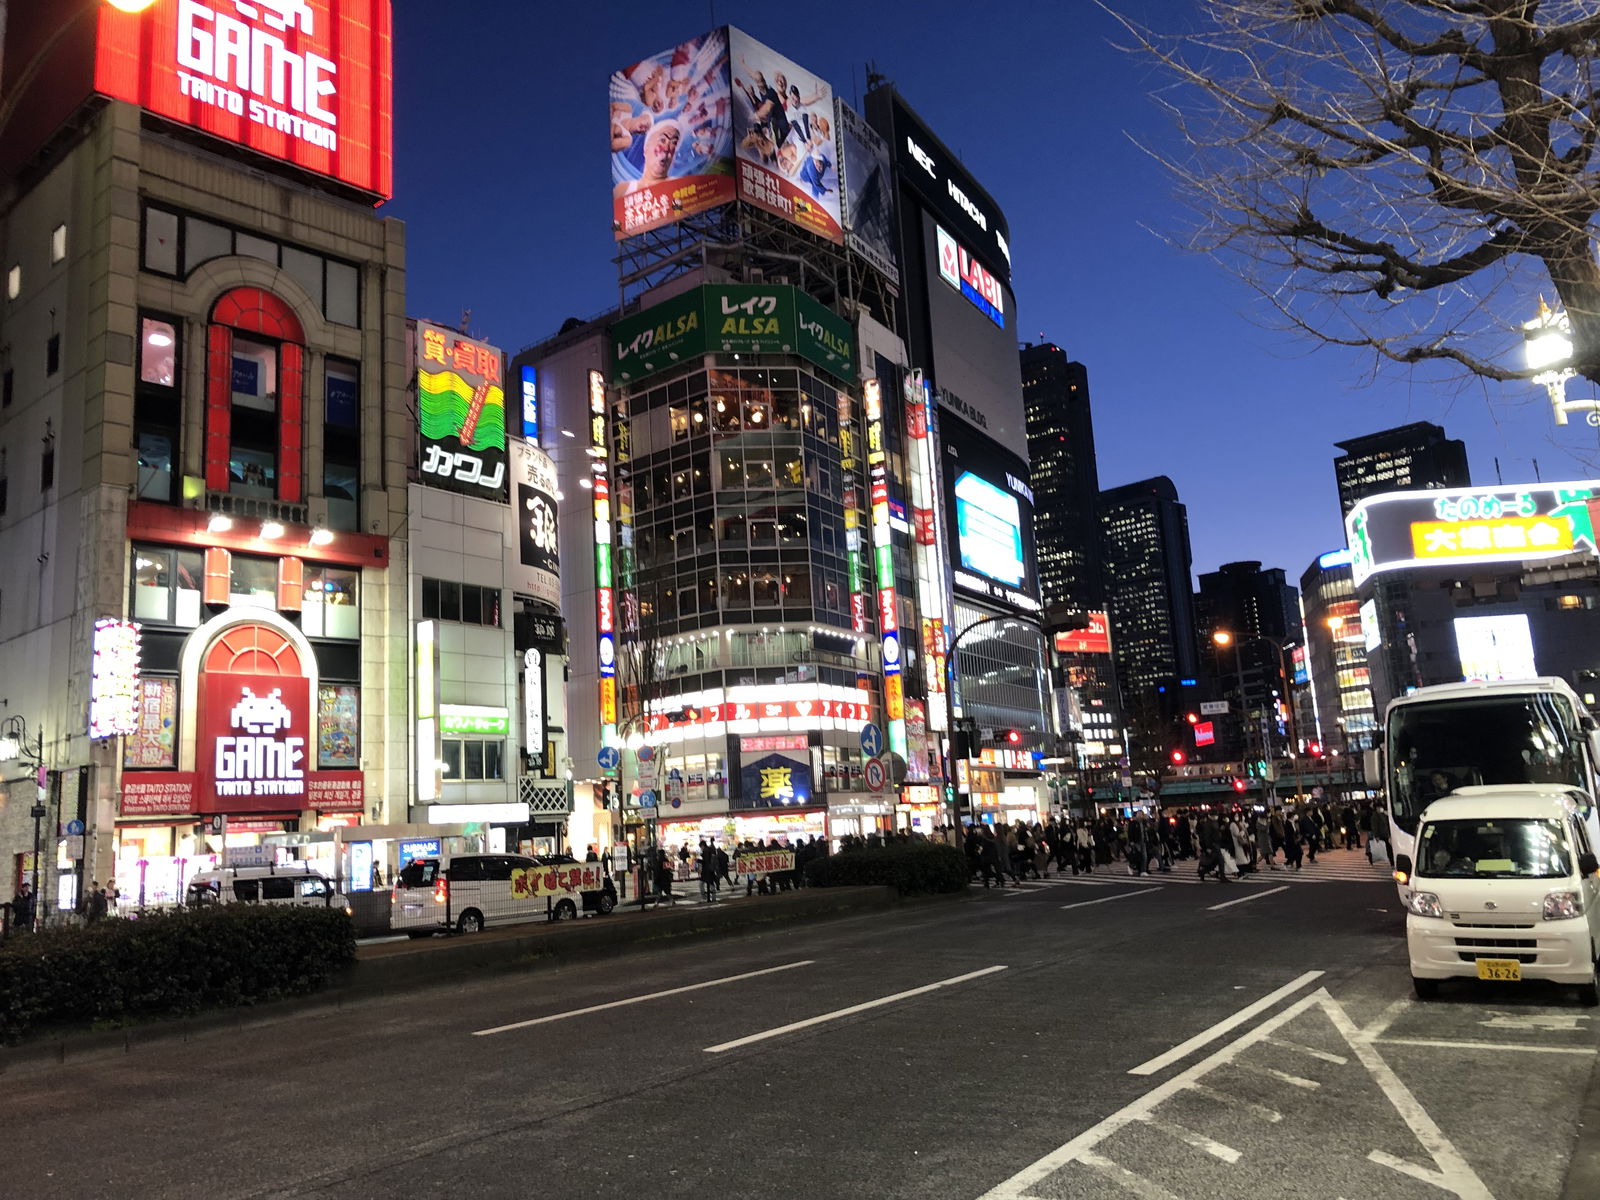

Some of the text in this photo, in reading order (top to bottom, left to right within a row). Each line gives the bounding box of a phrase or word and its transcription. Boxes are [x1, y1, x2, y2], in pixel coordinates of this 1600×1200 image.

[177, 0, 337, 125] GAME
[177, 70, 337, 151] TAITO STATION
[907, 136, 936, 179] NEC
[948, 179, 987, 231] HITACHI
[958, 245, 1004, 314] LABI
[721, 295, 777, 315] レイク
[721, 317, 780, 335] ALSA
[941, 387, 969, 417] YUNIKA
[422, 444, 505, 489] カワノ
[1434, 493, 1537, 520] たのめーる
[215, 736, 304, 779] GAME
[216, 780, 304, 795] TAITO STATION
[759, 766, 794, 799] 薬
[1487, 968, 1519, 979] 36-26
